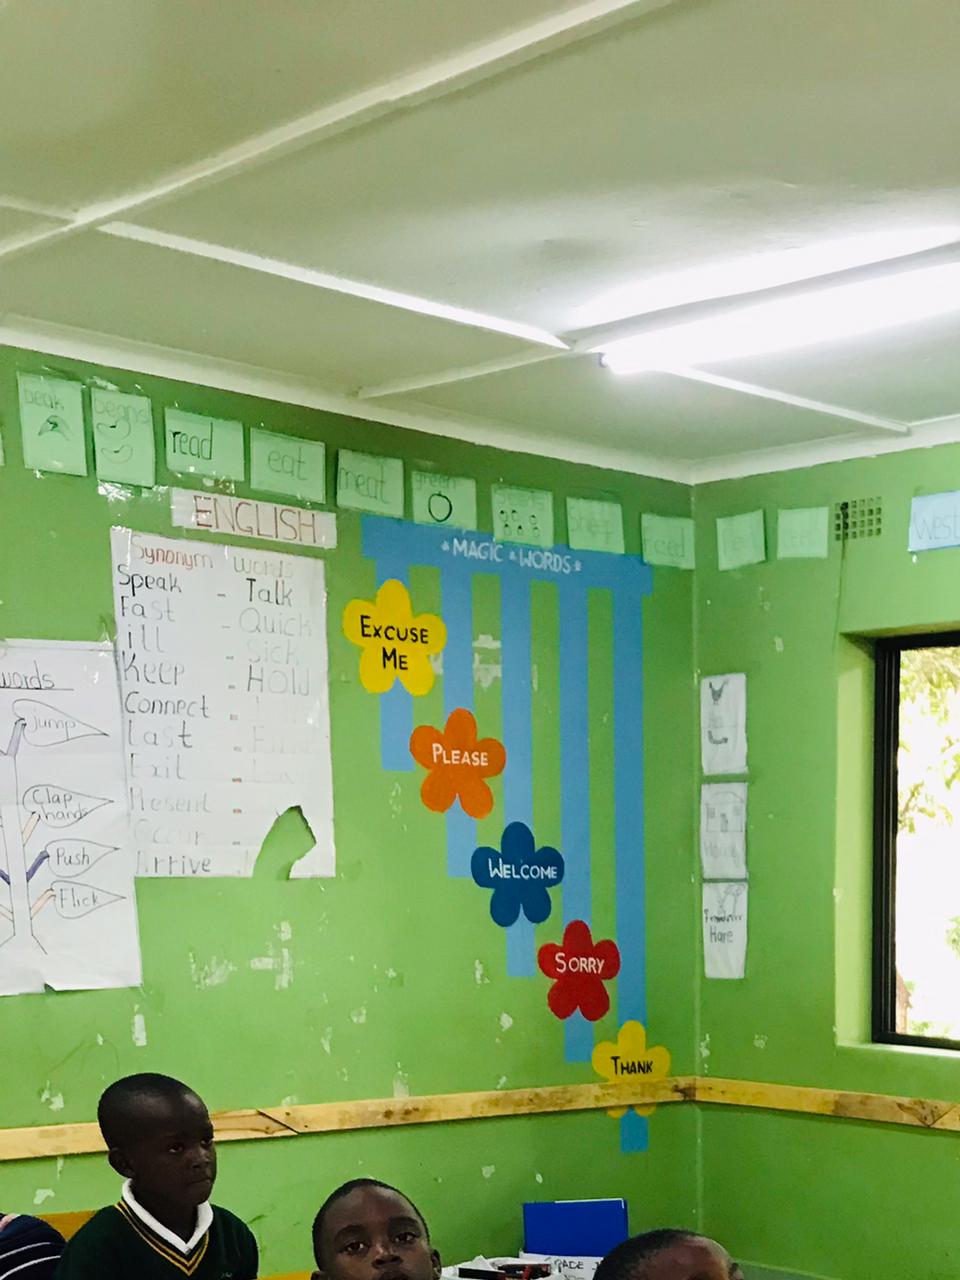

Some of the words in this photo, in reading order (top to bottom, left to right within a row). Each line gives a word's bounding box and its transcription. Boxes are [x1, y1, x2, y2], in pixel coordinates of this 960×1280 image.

[169, 421, 213, 461] read
[267, 446, 308, 481] eat
[338, 462, 390, 504] meat
[193, 494, 317, 544] ENGLISH
[131, 534, 214, 570] Synonym
[453, 538, 503, 563] MAGIC
[519, 548, 572, 574] WORDS
[116, 563, 182, 598] Speak
[246, 577, 293, 607] Talk
[120, 595, 176, 623] Fast
[238, 606, 313, 641] Quick
[122, 650, 186, 686] Keep
[124, 690, 211, 719] Connect
[127, 718, 194, 750] Last
[32, 788, 73, 807] Clap
[43, 804, 89, 822] hands
[56, 848, 91, 867] Push
[60, 886, 101, 908] Flick
